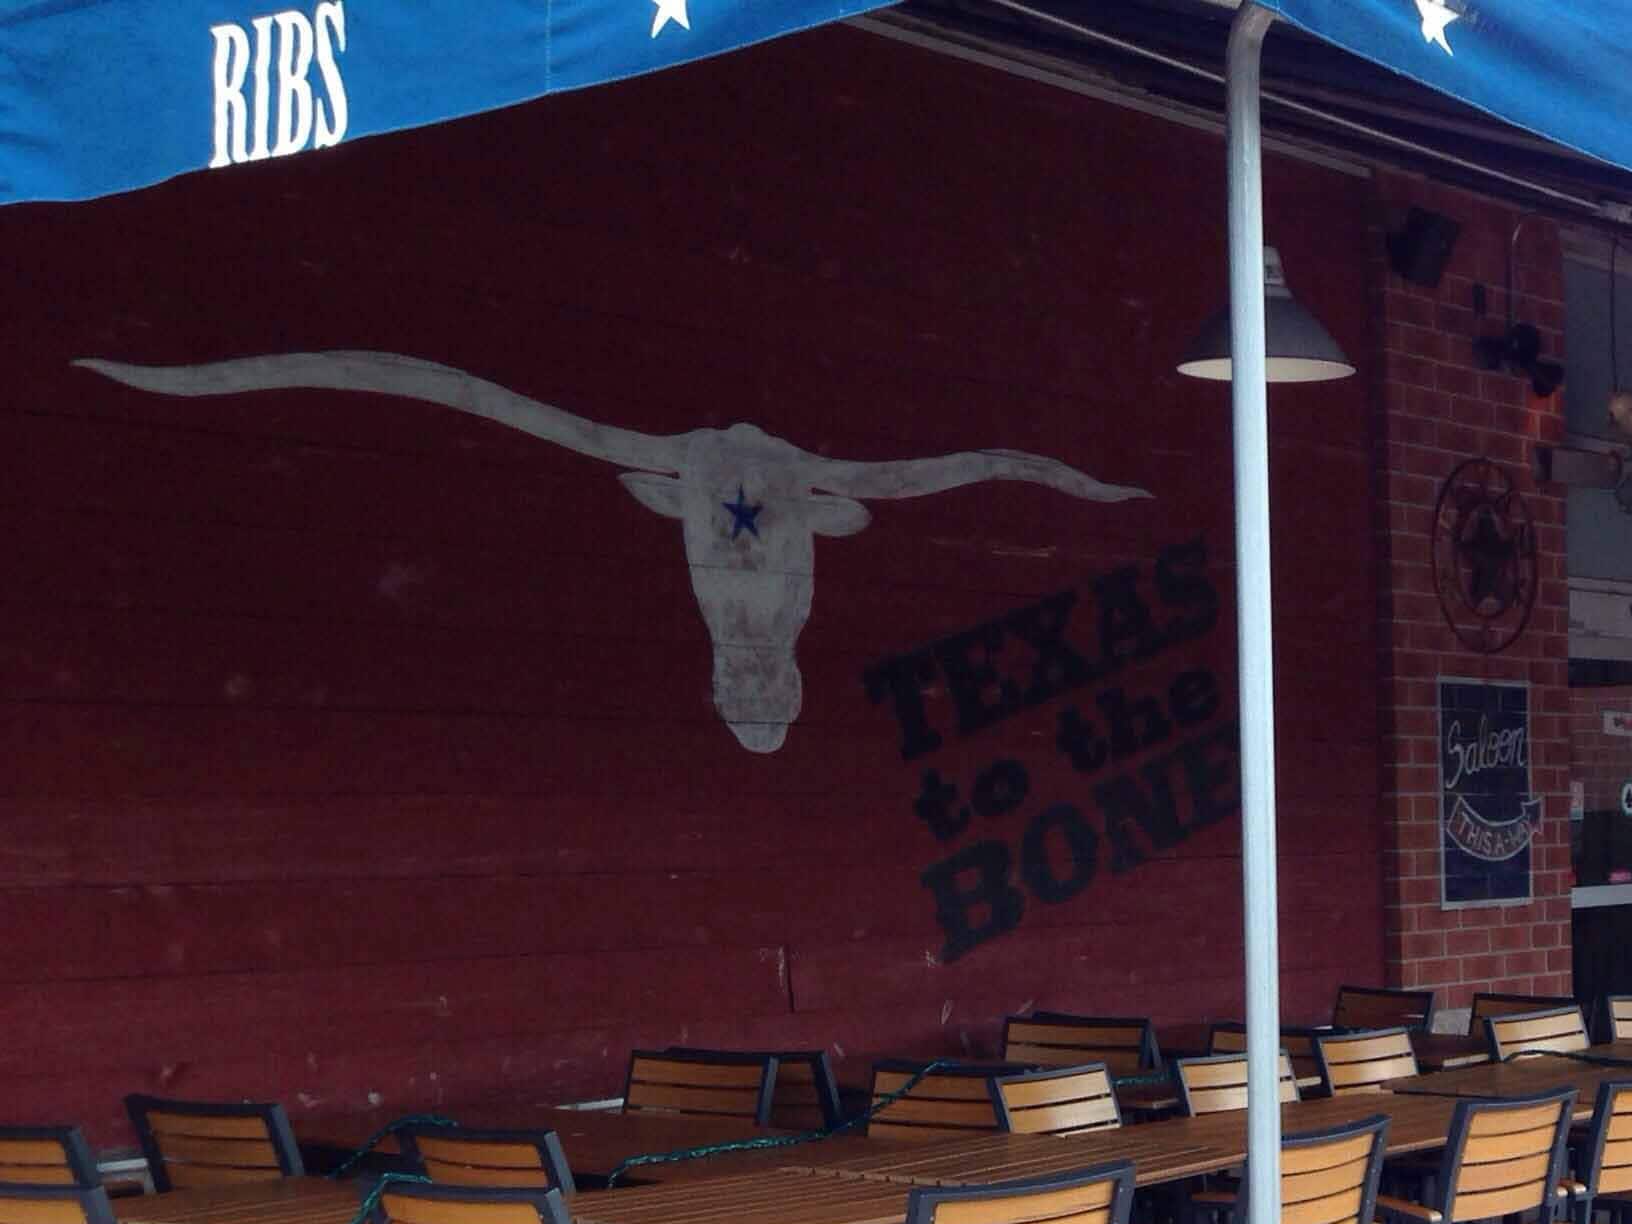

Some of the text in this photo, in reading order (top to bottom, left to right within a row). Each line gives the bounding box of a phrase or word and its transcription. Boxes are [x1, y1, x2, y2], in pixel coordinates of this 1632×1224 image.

[209, 0, 348, 169] RIBS
[863, 531, 1220, 762] TEXAS
[915, 666, 1219, 841] to the
[919, 720, 1243, 964] BONE
